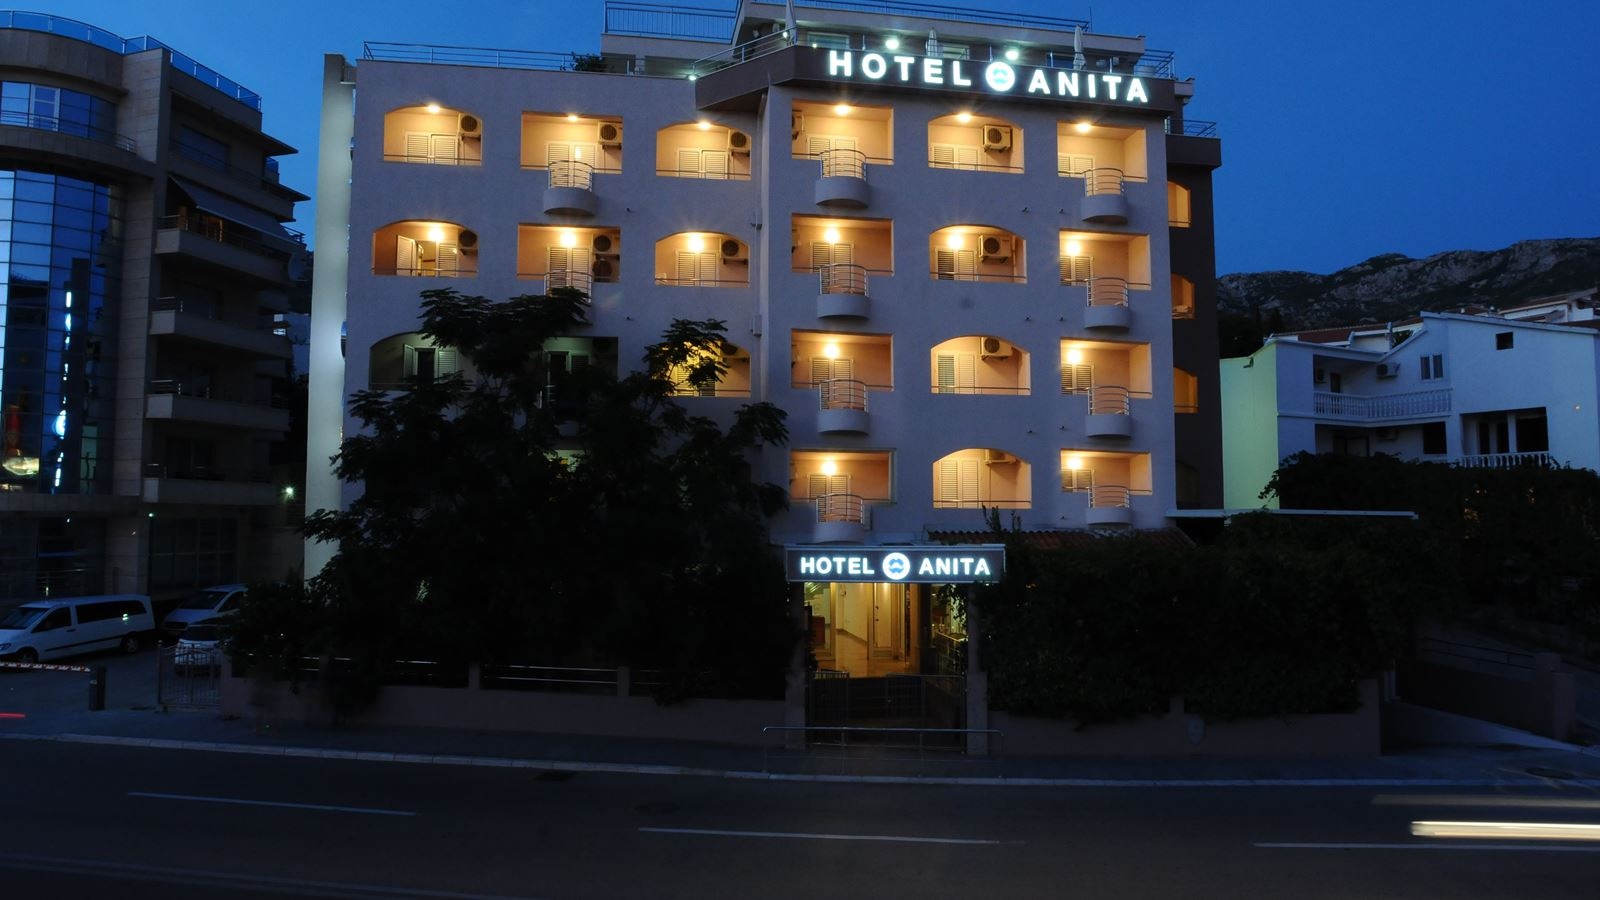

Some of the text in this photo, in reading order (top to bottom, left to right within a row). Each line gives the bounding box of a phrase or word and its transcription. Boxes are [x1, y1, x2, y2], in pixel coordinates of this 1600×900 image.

[828, 49, 1149, 103] HOTEL ANITA
[800, 556, 991, 576] HOTEL ANITA
